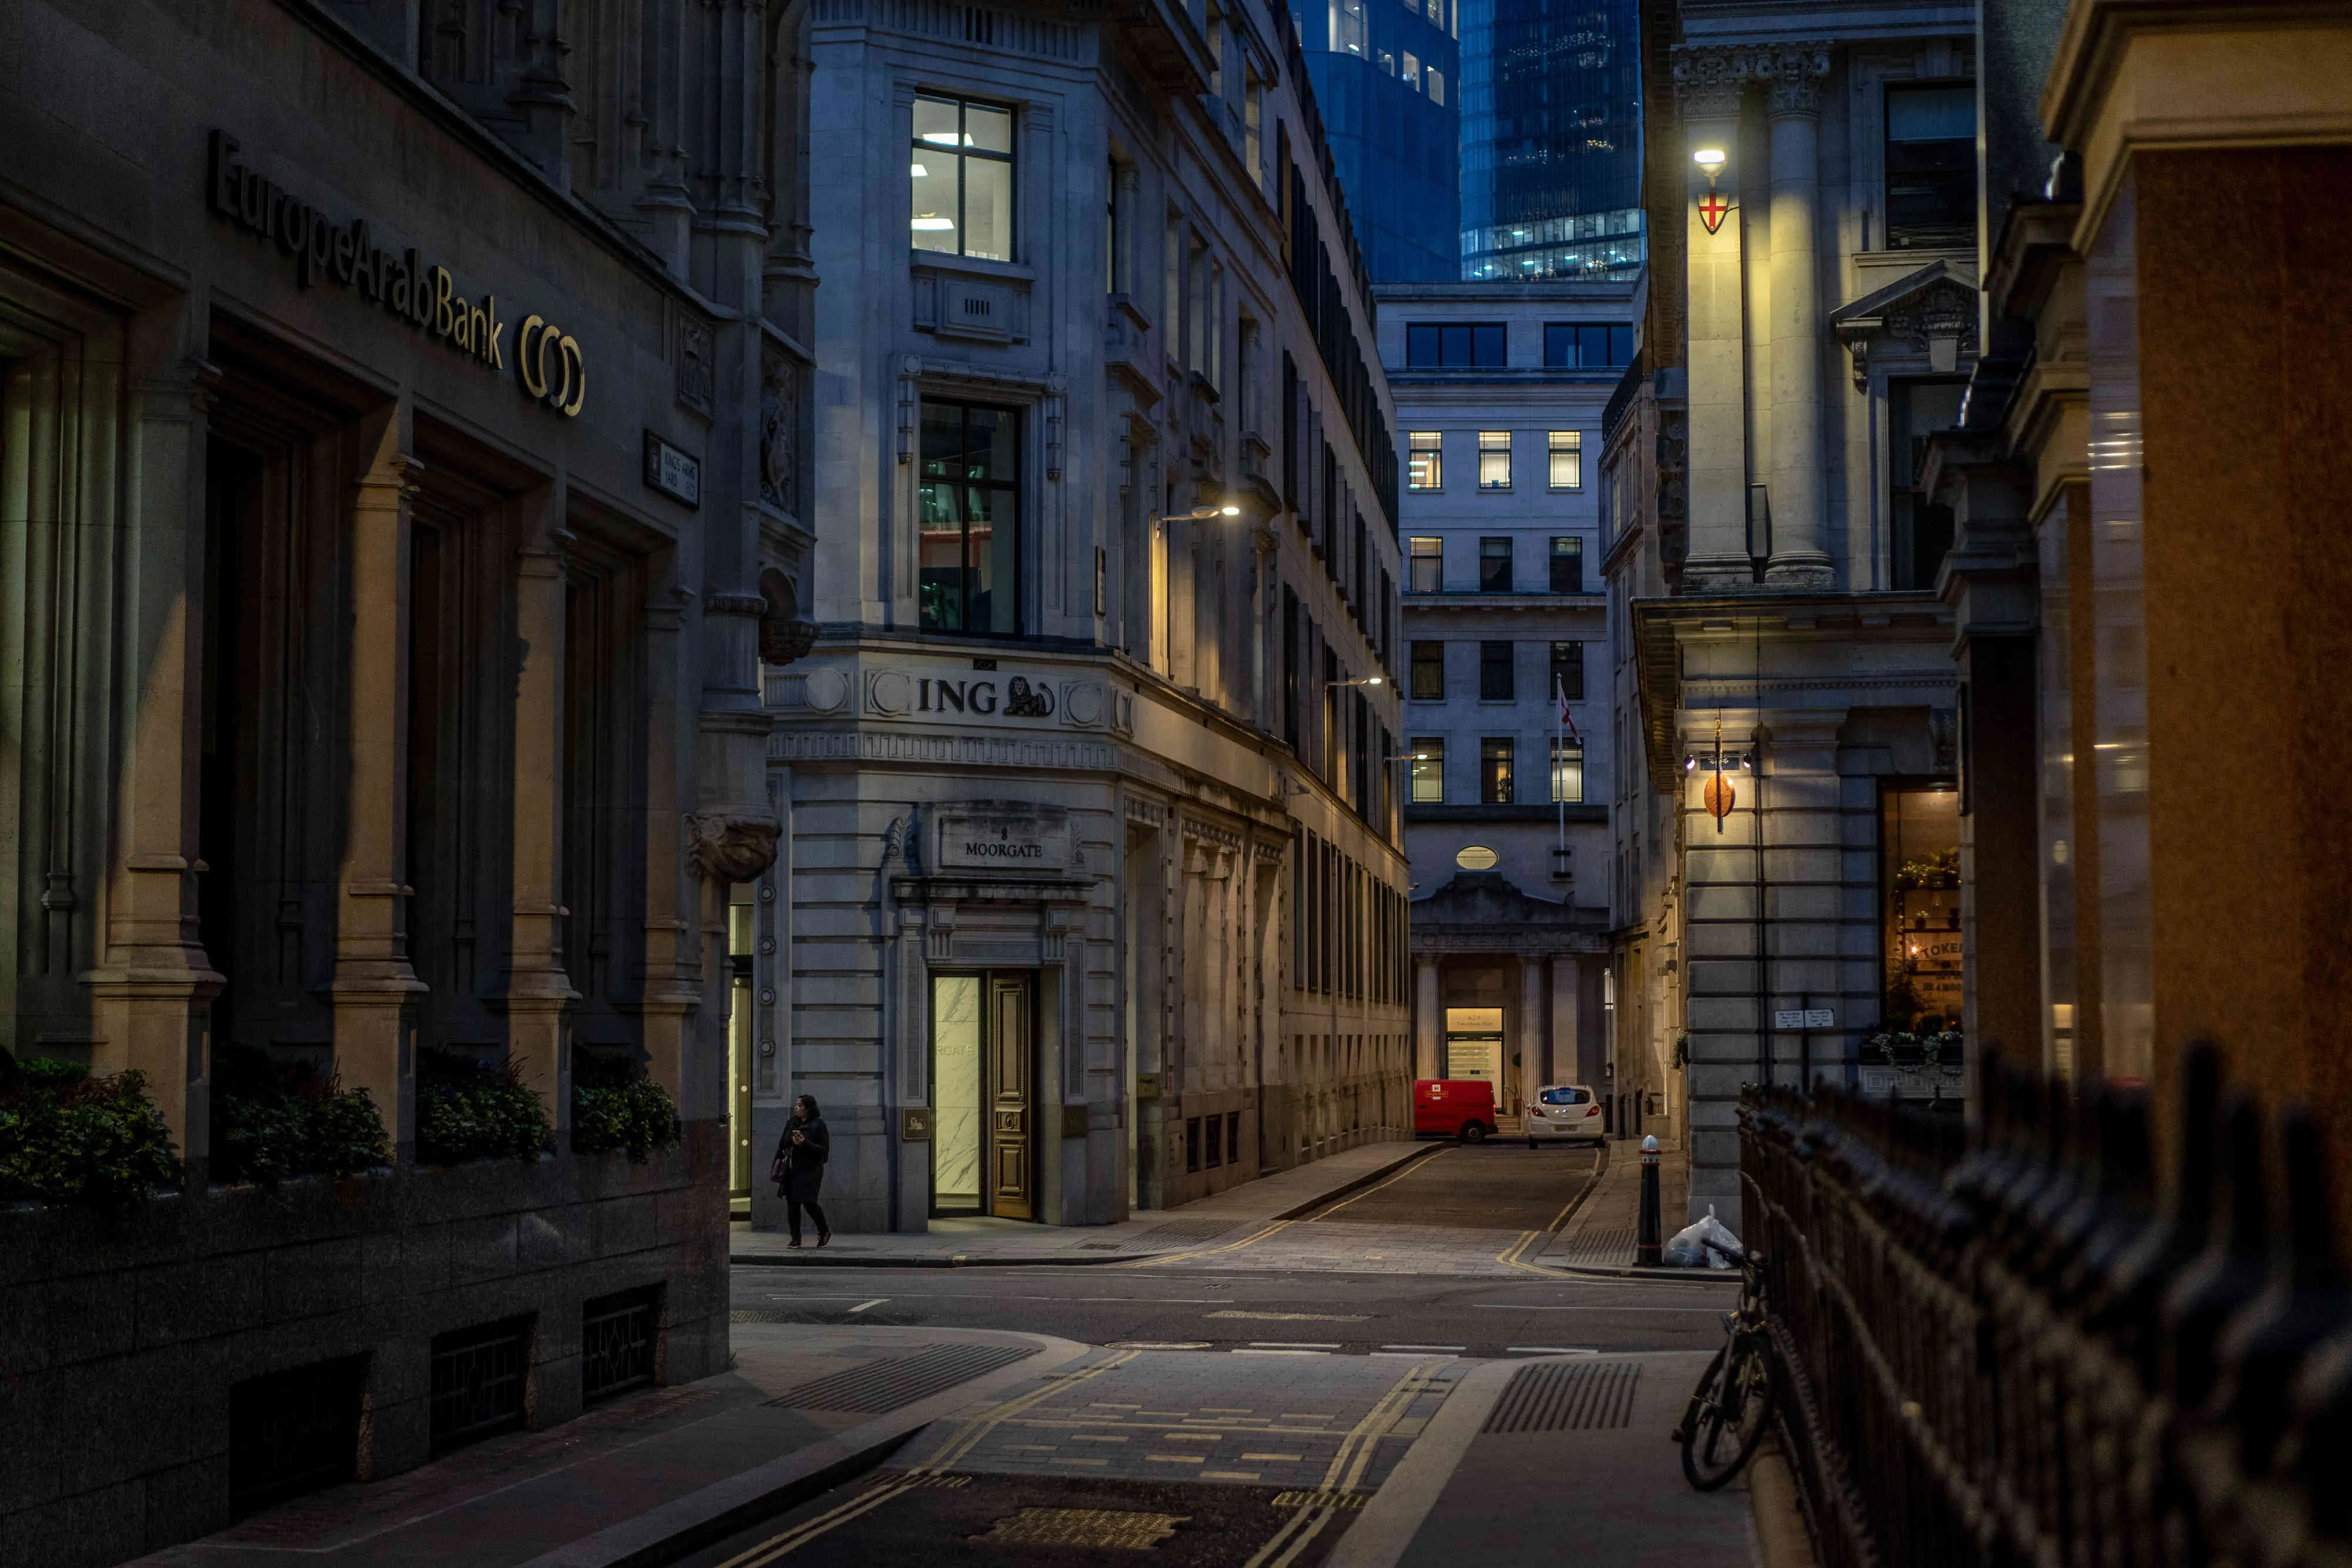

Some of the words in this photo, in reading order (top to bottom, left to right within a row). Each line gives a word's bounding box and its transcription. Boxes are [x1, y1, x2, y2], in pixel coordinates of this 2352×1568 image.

[208, 129, 503, 370] EuropeArabBank
[918, 678, 998, 714] ING
[1001, 828, 1008, 841] 8
[965, 842, 1043, 857] MOORGATE
